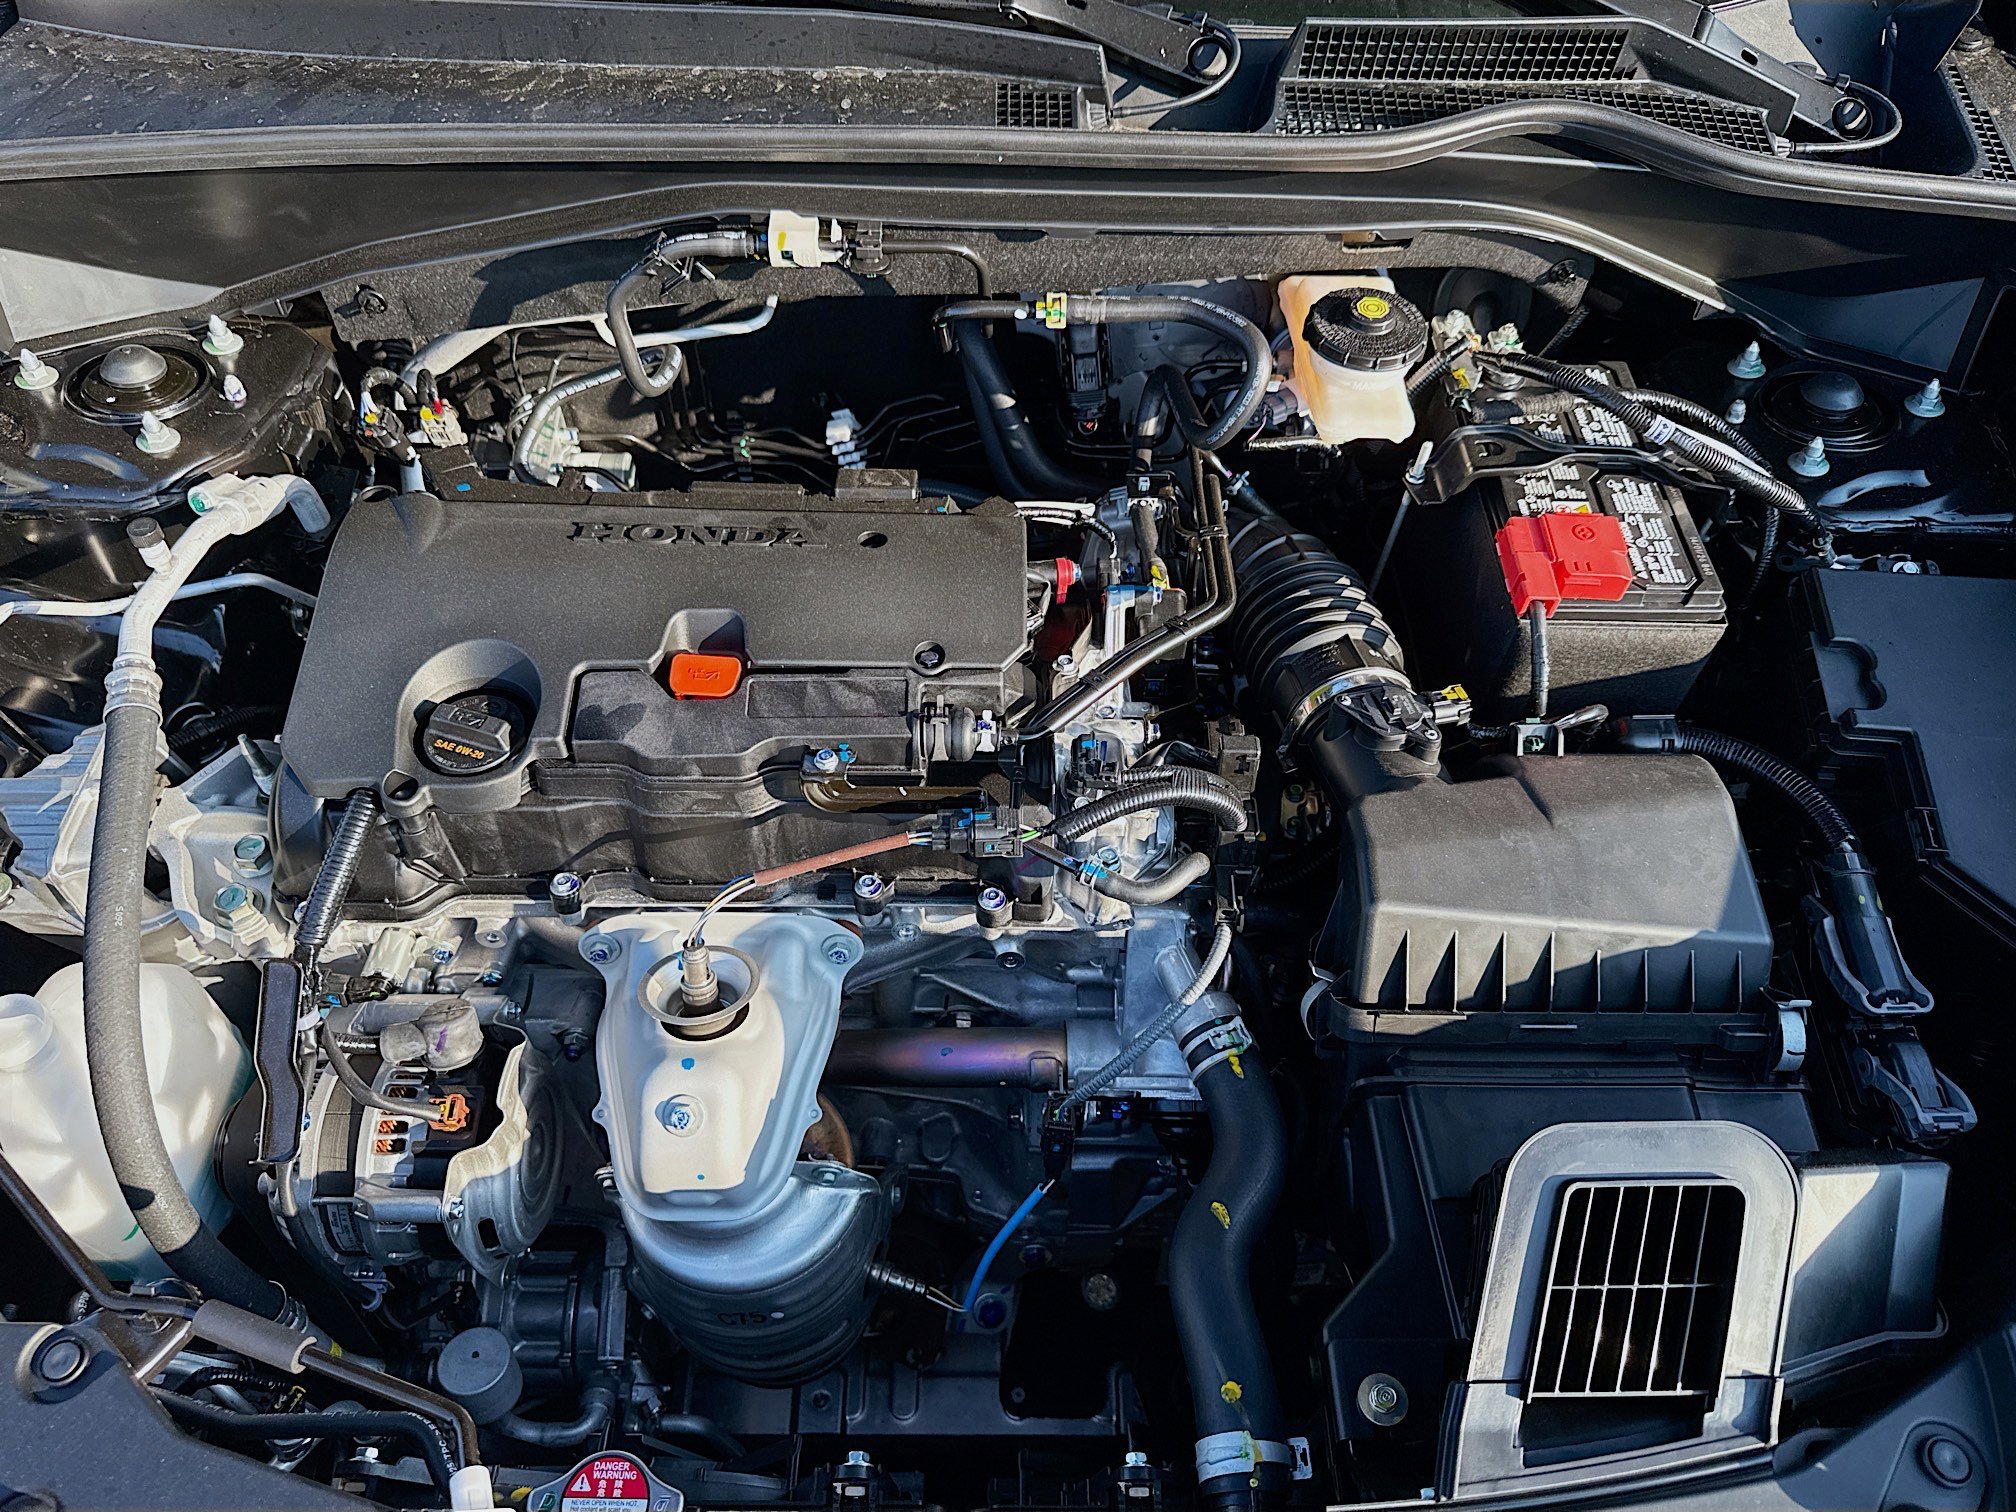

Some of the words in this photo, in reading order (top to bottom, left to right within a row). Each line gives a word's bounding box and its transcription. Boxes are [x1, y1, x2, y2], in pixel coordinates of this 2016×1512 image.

[567, 521, 828, 549] HONDA
[434, 738, 457, 751] SAE
[455, 745, 485, 760] 0W-20
[594, 1461, 631, 1471] DANGER
[592, 1470, 638, 1480] WARNUNG
